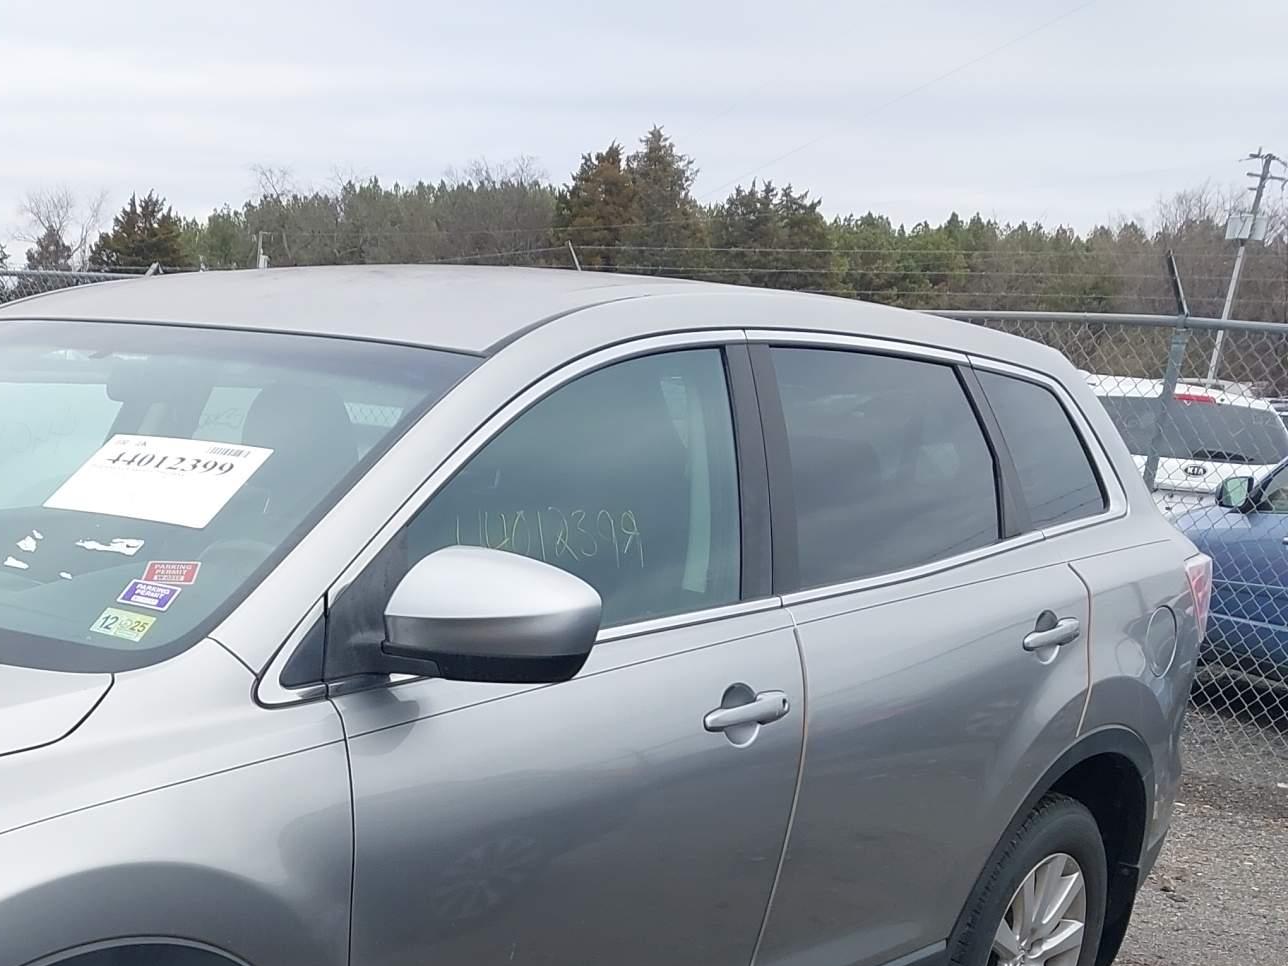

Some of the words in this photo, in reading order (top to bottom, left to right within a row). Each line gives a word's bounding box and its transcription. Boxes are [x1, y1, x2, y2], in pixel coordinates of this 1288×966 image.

[106, 451, 235, 476] 44012399
[134, 589, 164, 599] PERMIT
[136, 583, 171, 594] PARKING
[99, 614, 119, 630] 12
[130, 620, 150, 633] 25
